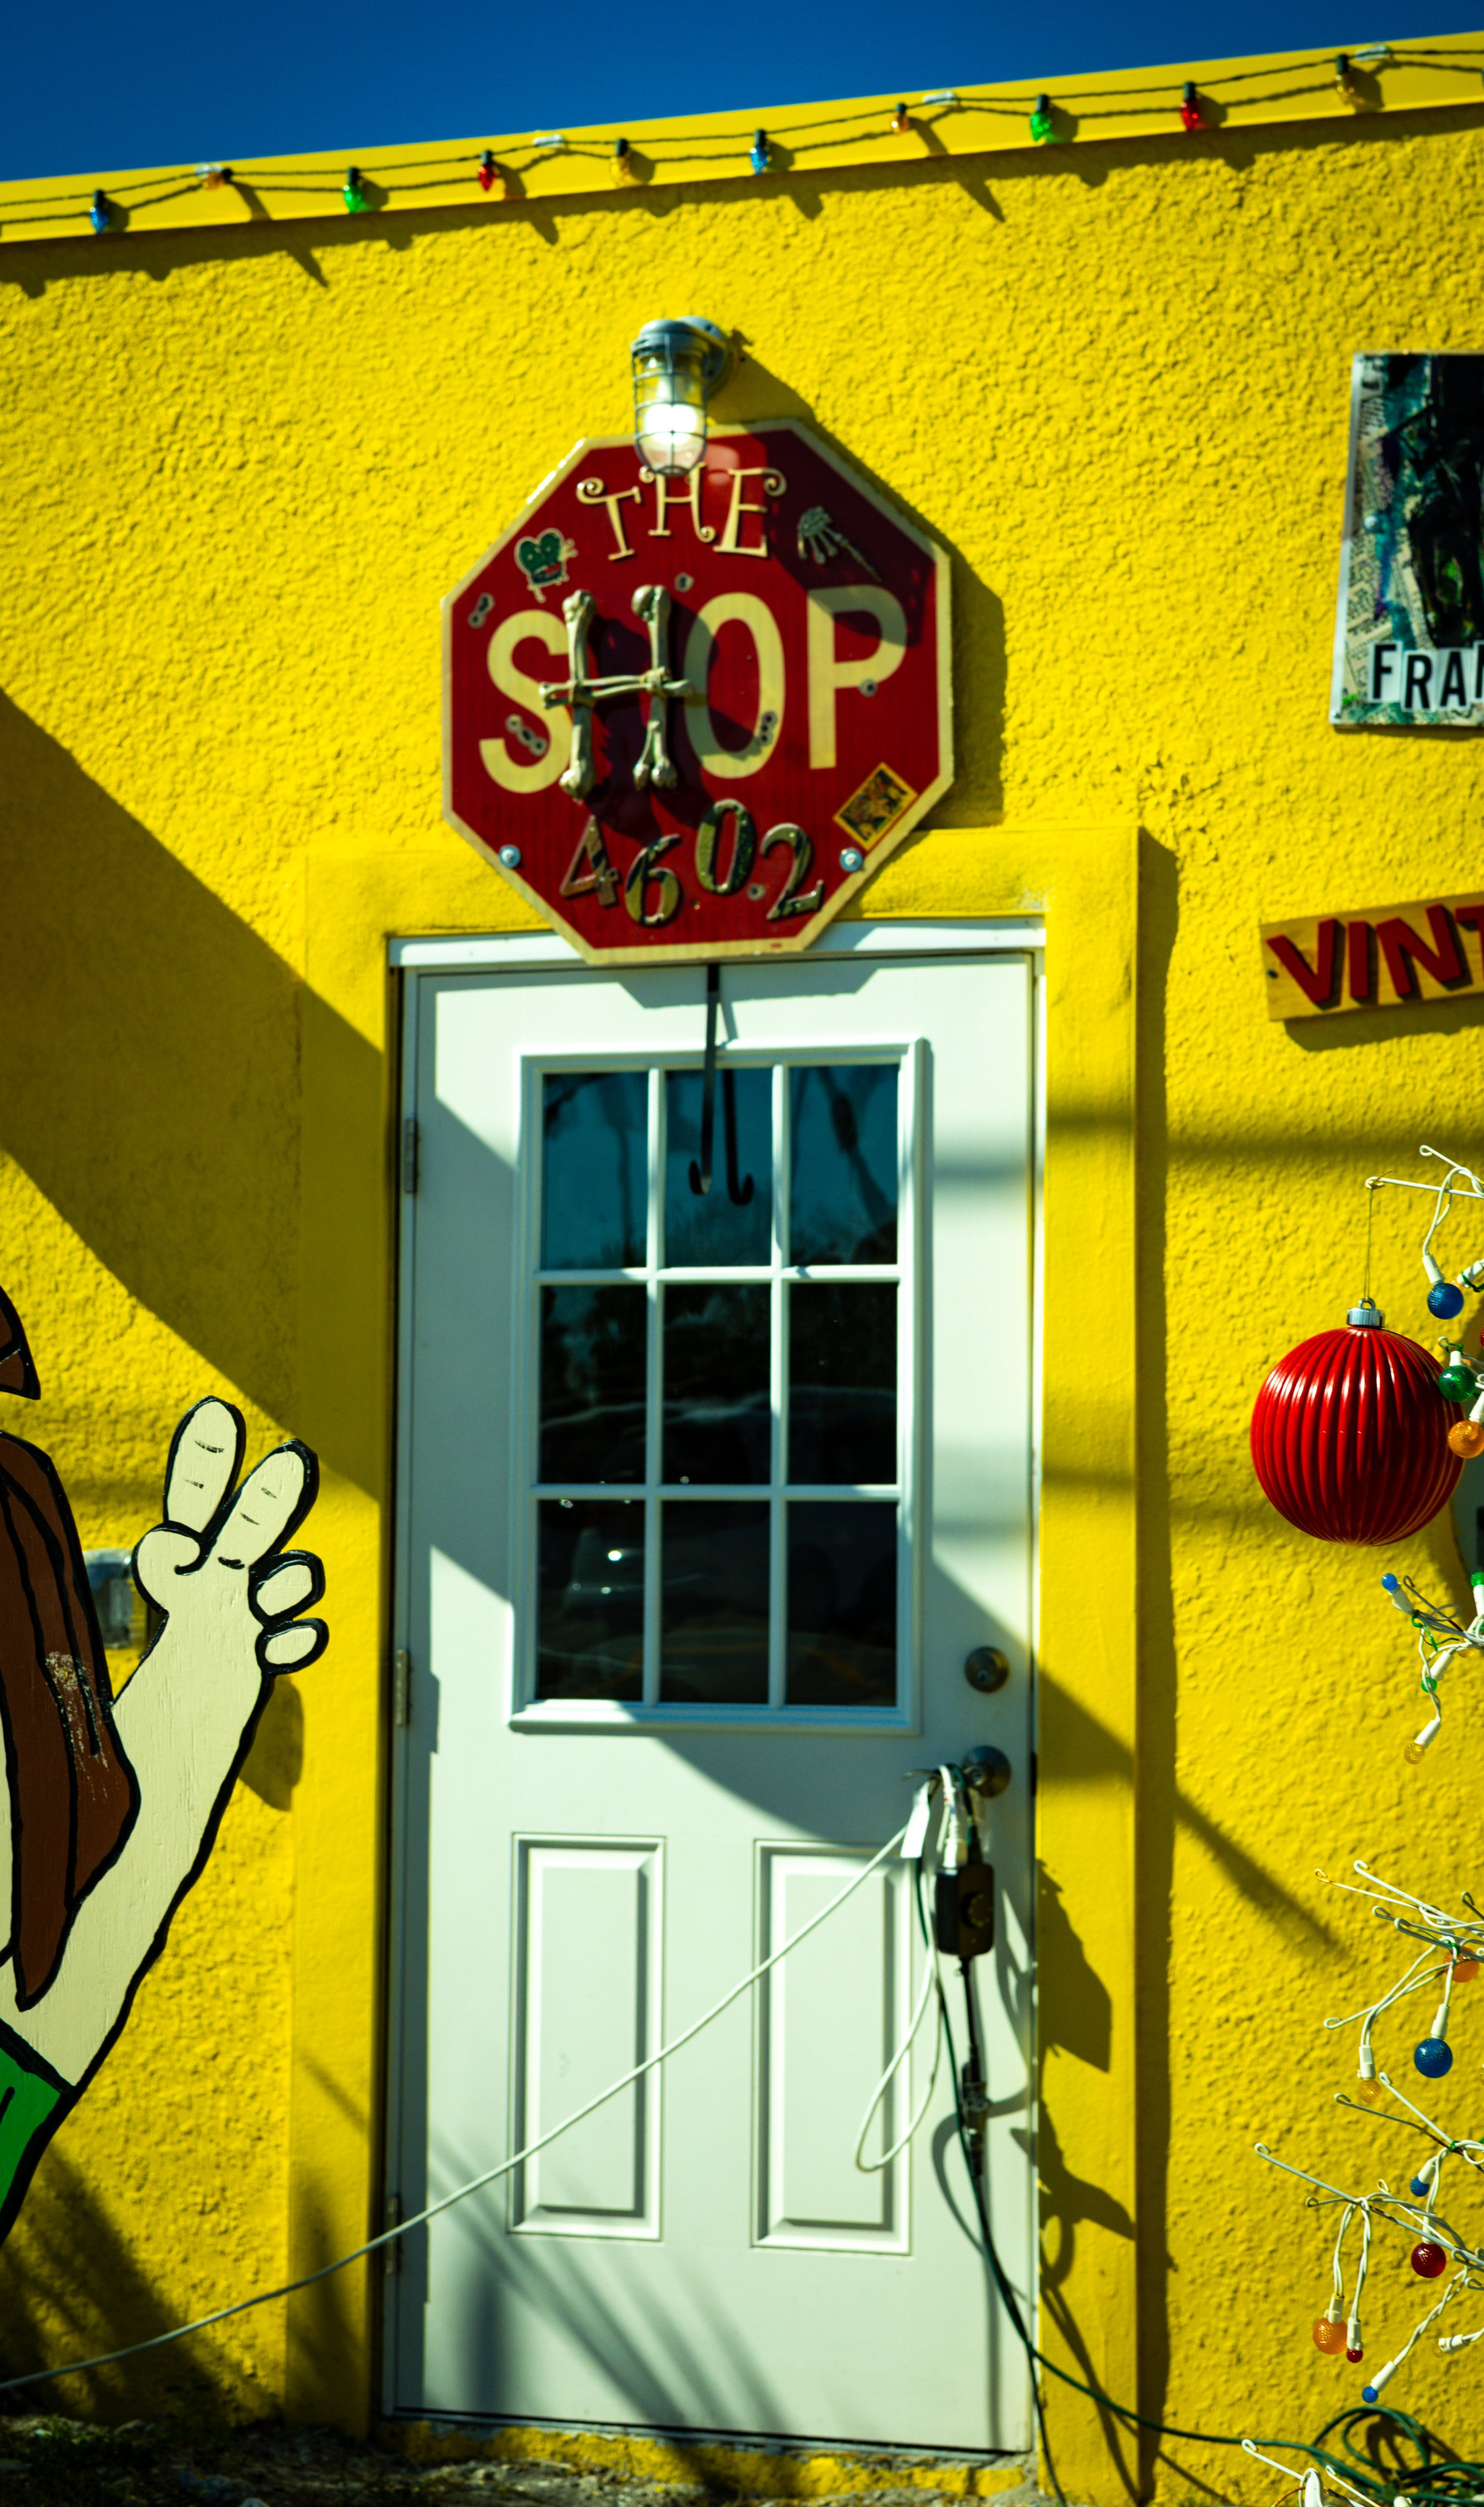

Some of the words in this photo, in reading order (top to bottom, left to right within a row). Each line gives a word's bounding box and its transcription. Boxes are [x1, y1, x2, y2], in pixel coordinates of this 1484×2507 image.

[576, 462, 786, 559] THE
[479, 585, 906, 801] SHOP
[559, 798, 824, 926] 4602
